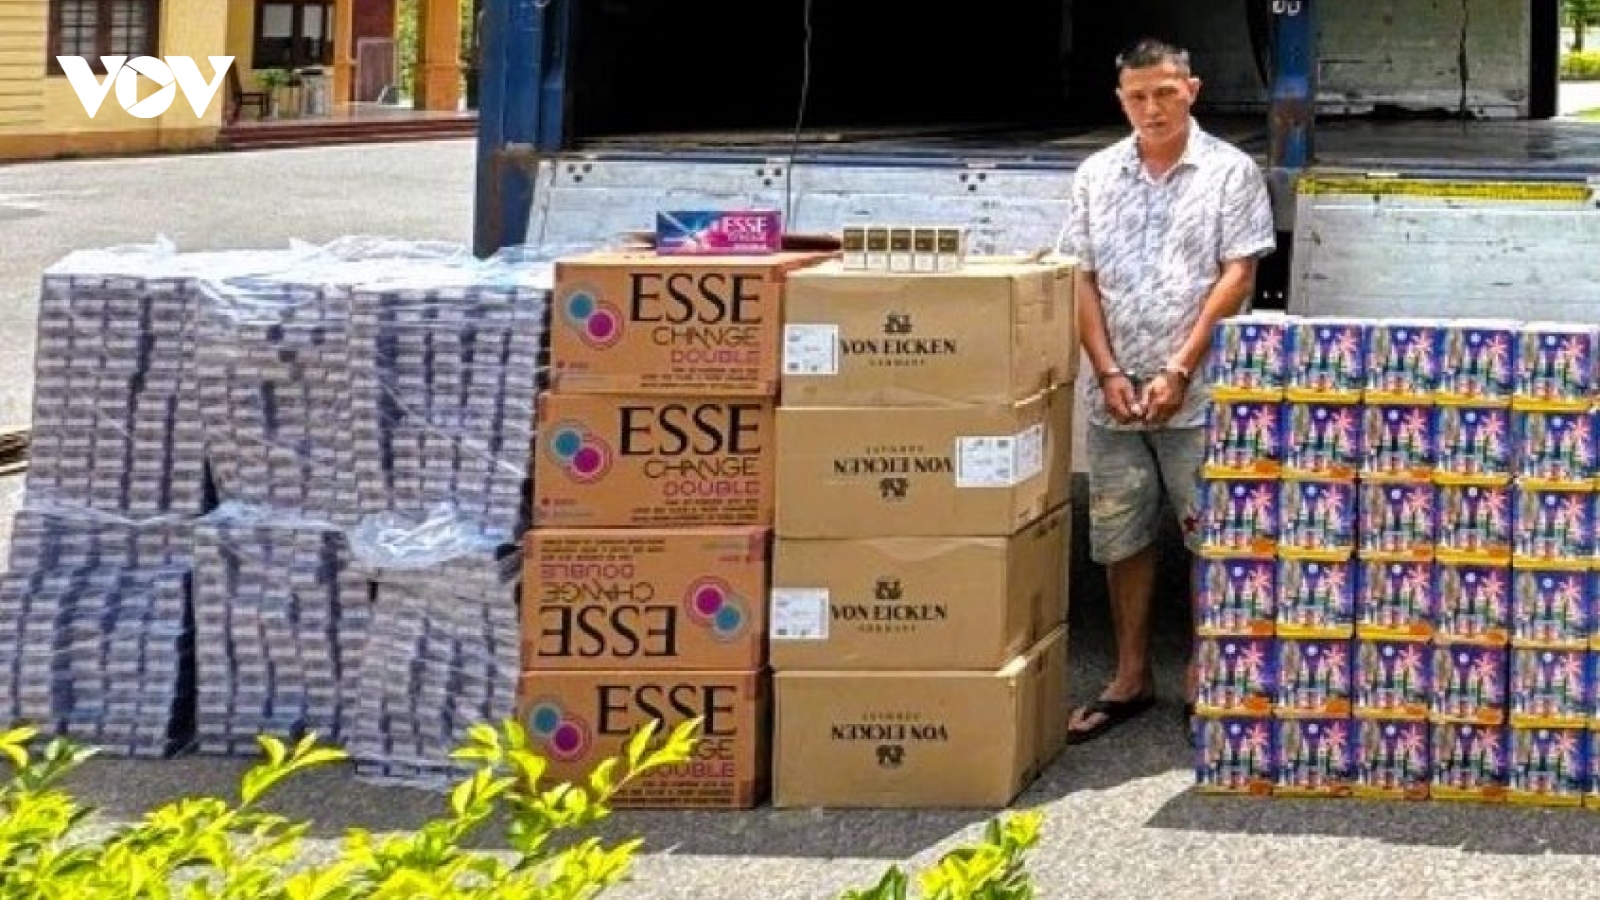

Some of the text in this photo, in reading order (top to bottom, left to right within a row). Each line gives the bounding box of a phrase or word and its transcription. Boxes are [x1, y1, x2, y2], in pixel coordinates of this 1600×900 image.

[722, 216, 767, 232] ESSE
[630, 272, 762, 325] ESSE
[653, 326, 760, 348] CHANGE
[840, 338, 956, 354] VON EICKEN
[671, 350, 760, 364] DOUBLE
[619, 403, 762, 456] ESSE
[643, 456, 759, 479] CHANGE
[834, 457, 953, 474] VON EICKEN
[663, 481, 760, 496] DOUBLE
[541, 564, 635, 579] DOUBLE
[543, 579, 655, 603] CHANGE
[832, 604, 948, 621] VON EICKEN
[538, 605, 678, 656] ESSE
[597, 683, 736, 735] ESSE
[832, 724, 948, 741] VON EICKEN
